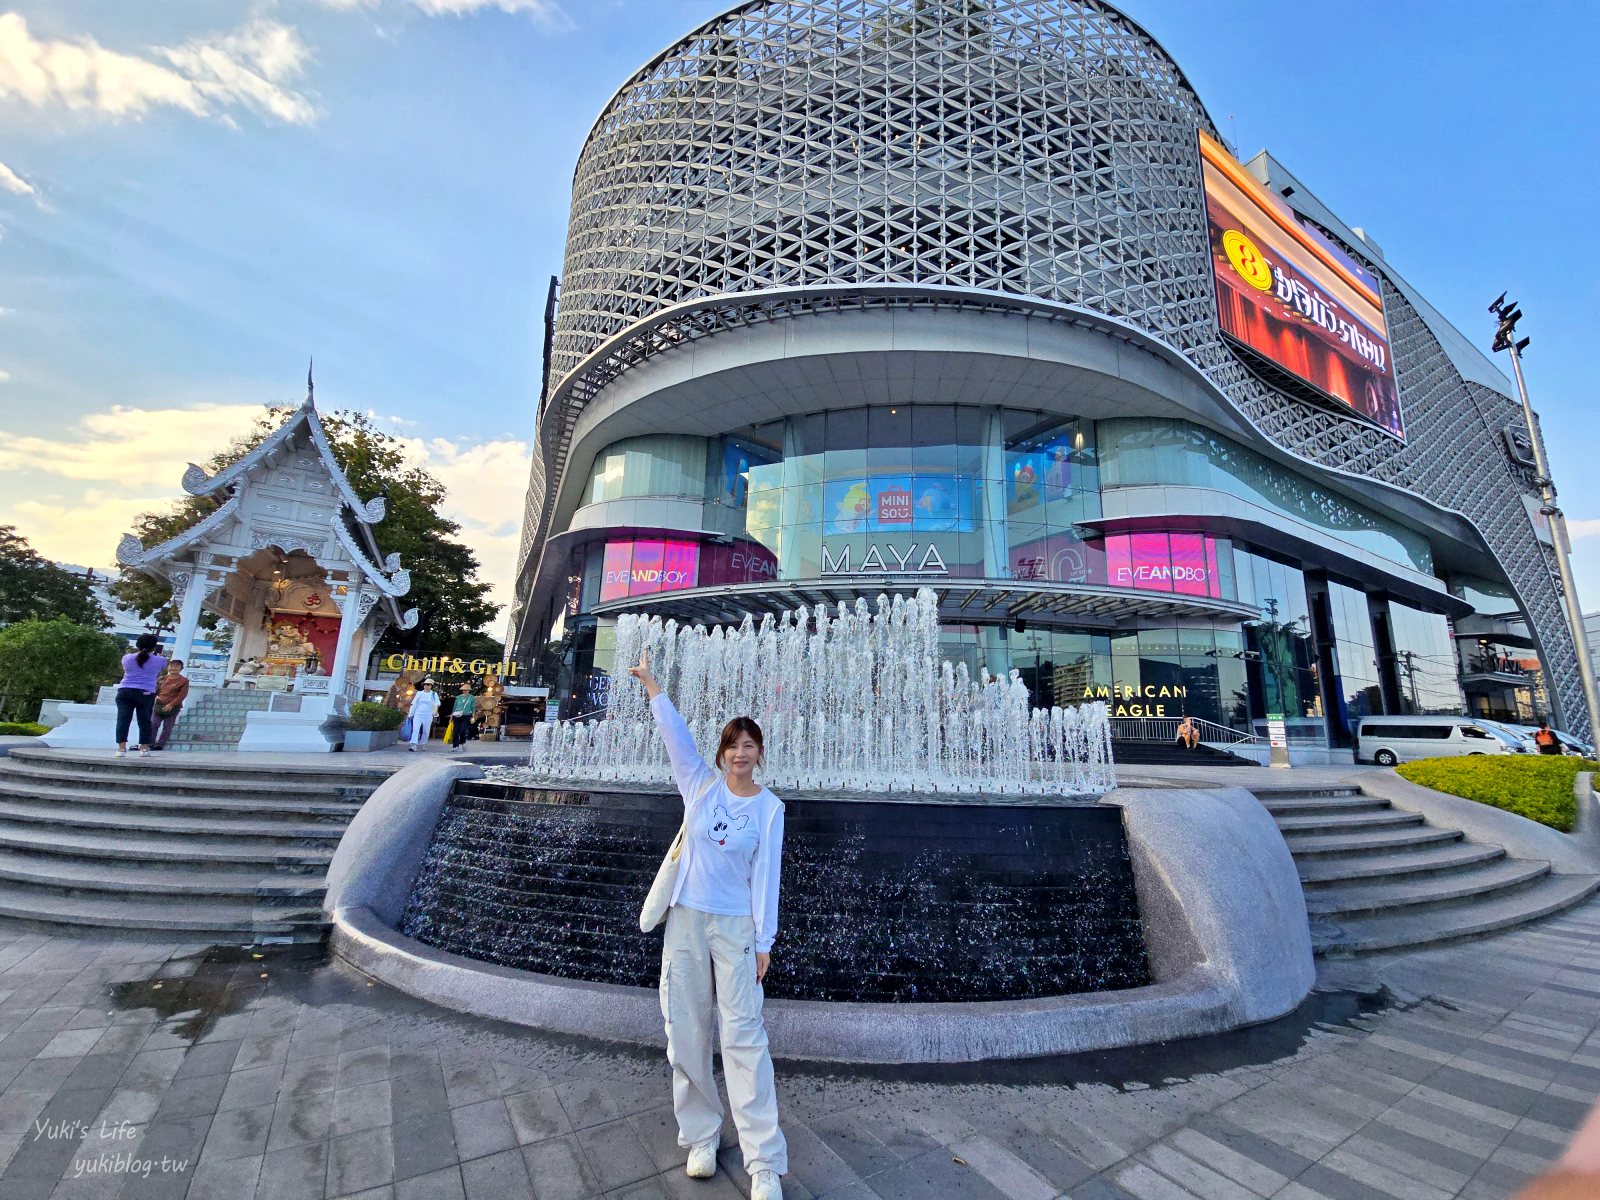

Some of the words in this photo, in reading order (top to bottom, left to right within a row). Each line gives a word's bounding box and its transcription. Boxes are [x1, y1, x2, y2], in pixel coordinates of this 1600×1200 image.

[881, 495, 909, 507] MINI
[820, 543, 949, 572] MAYA
[606, 569, 688, 584] EVEANDBOY
[1083, 685, 1187, 698] AMERICAN
[1104, 704, 1165, 717] EAGLE
